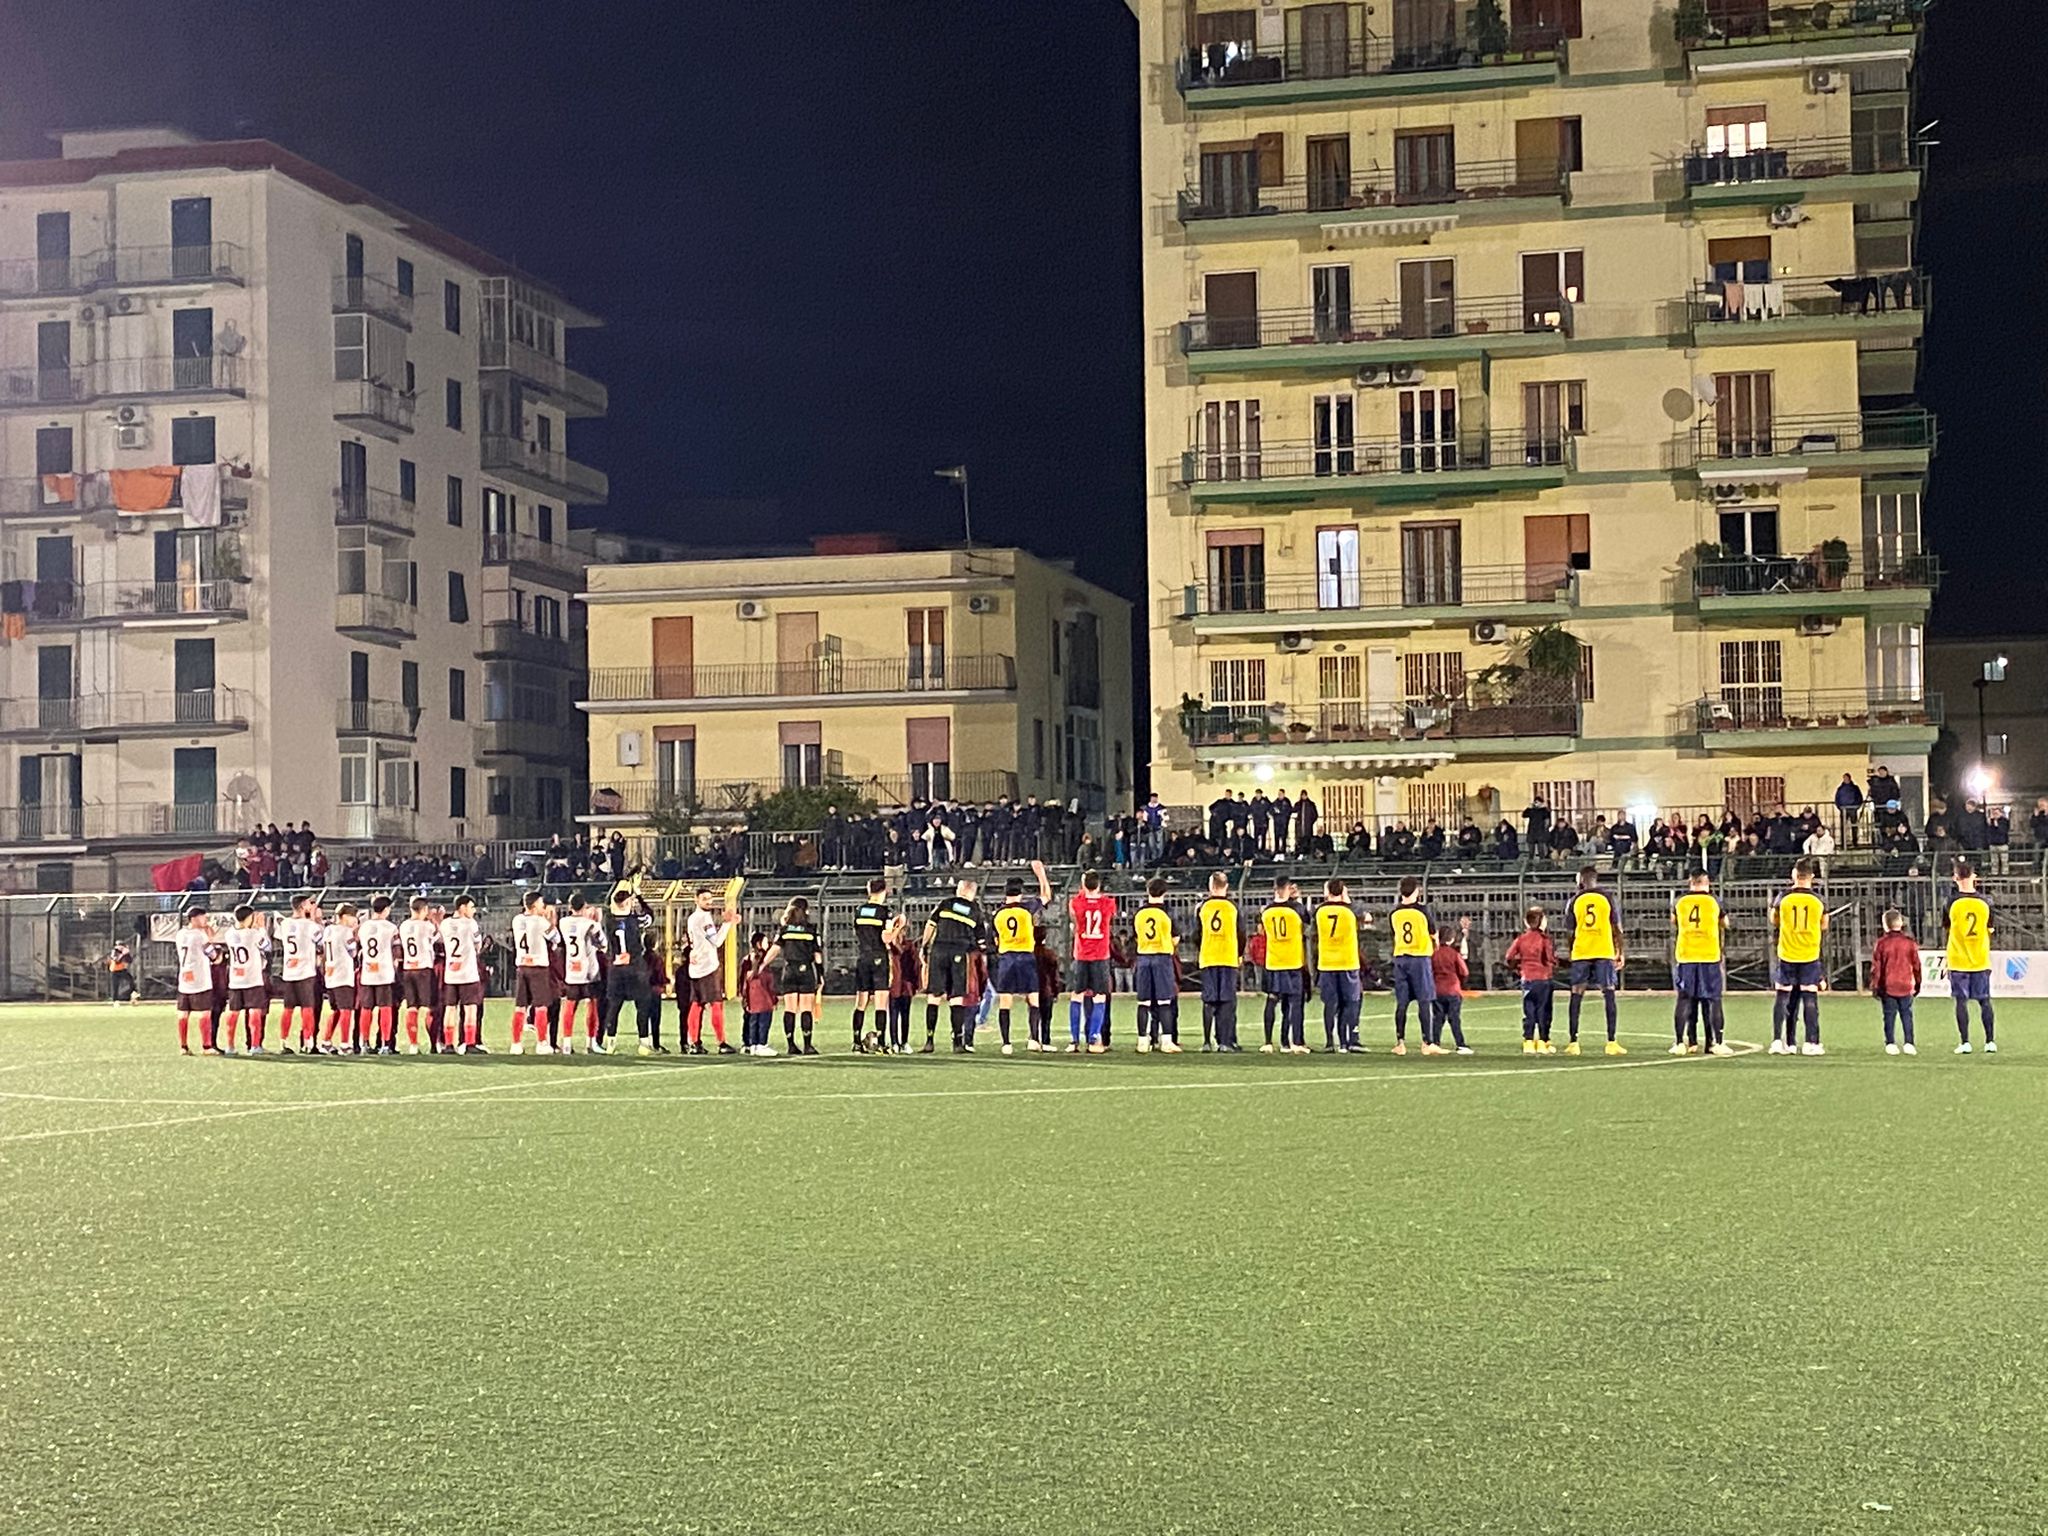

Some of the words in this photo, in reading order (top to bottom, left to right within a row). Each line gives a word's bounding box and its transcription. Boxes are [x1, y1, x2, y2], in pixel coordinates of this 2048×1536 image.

[1006, 916, 1018, 938] 9
[1084, 909, 1101, 937] 12
[1210, 909, 1222, 932] 6
[1327, 914, 1338, 938] 7
[1585, 903, 1596, 928] 5
[1688, 904, 1700, 929] 4
[1791, 905, 1809, 931] 11
[1965, 912, 1977, 937] 2
[1145, 917, 1156, 940] 3
[1271, 916, 1287, 939] 10
[1402, 921, 1413, 944] 8
[287, 935, 298, 955] 5
[367, 937, 379, 958] 8
[407, 937, 418, 957] 6
[450, 937, 462, 958] 2
[519, 932, 530, 954] 4
[569, 935, 579, 957] 3
[614, 929, 628, 953] 1
[181, 946, 188, 967] 7
[231, 946, 250, 964] 10
